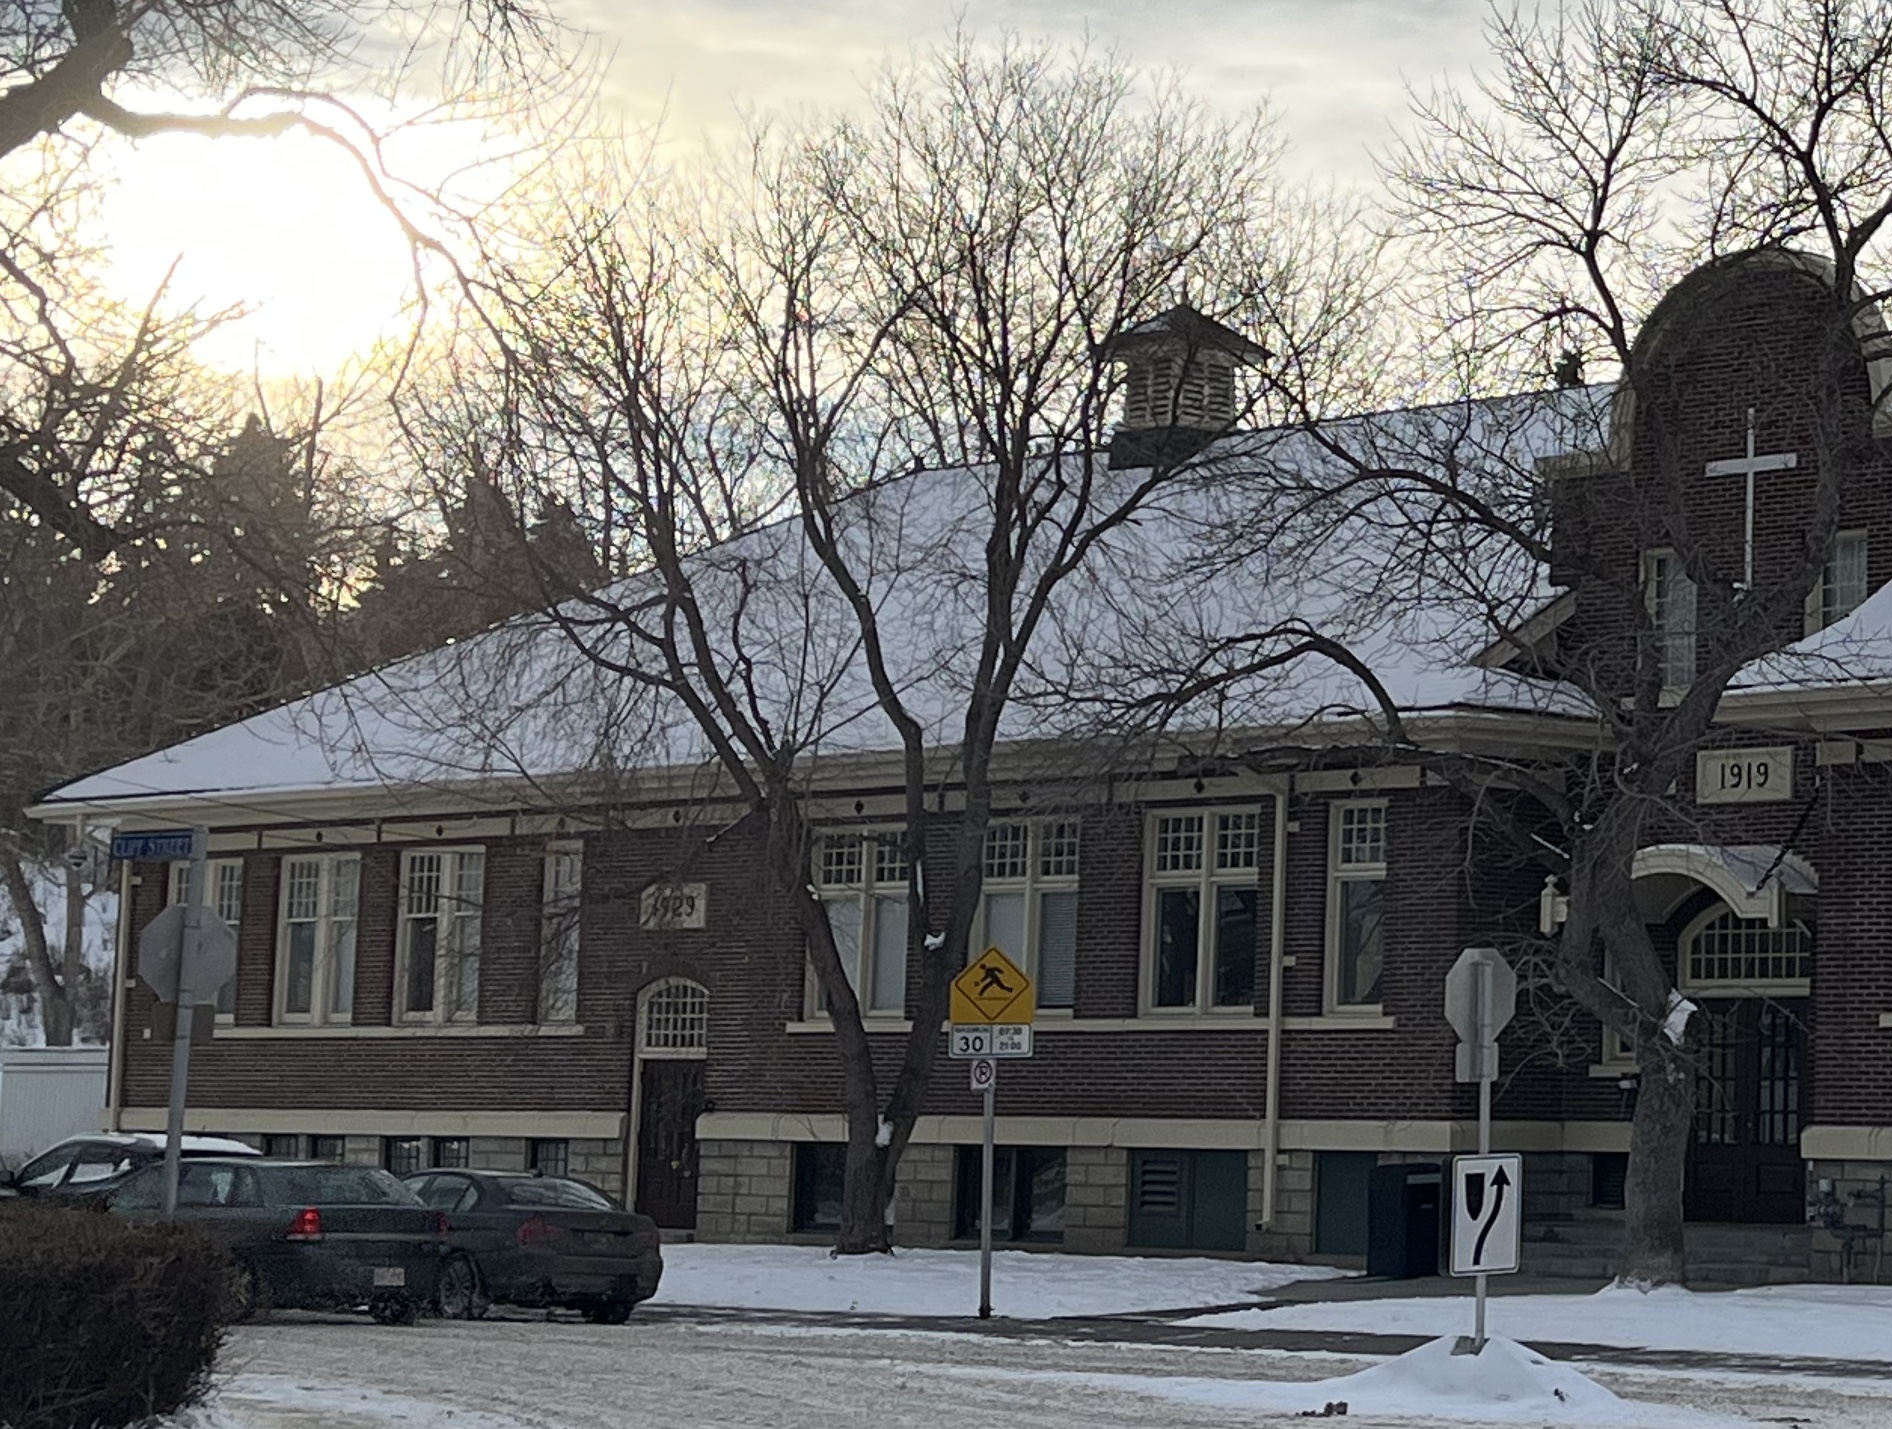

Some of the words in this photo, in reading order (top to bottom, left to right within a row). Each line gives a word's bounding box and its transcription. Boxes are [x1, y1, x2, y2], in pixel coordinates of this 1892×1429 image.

[1720, 762, 1769, 790] 1919
[146, 837, 191, 857] STREET
[652, 895, 696, 918] 1929
[959, 1035, 984, 1053] 30
